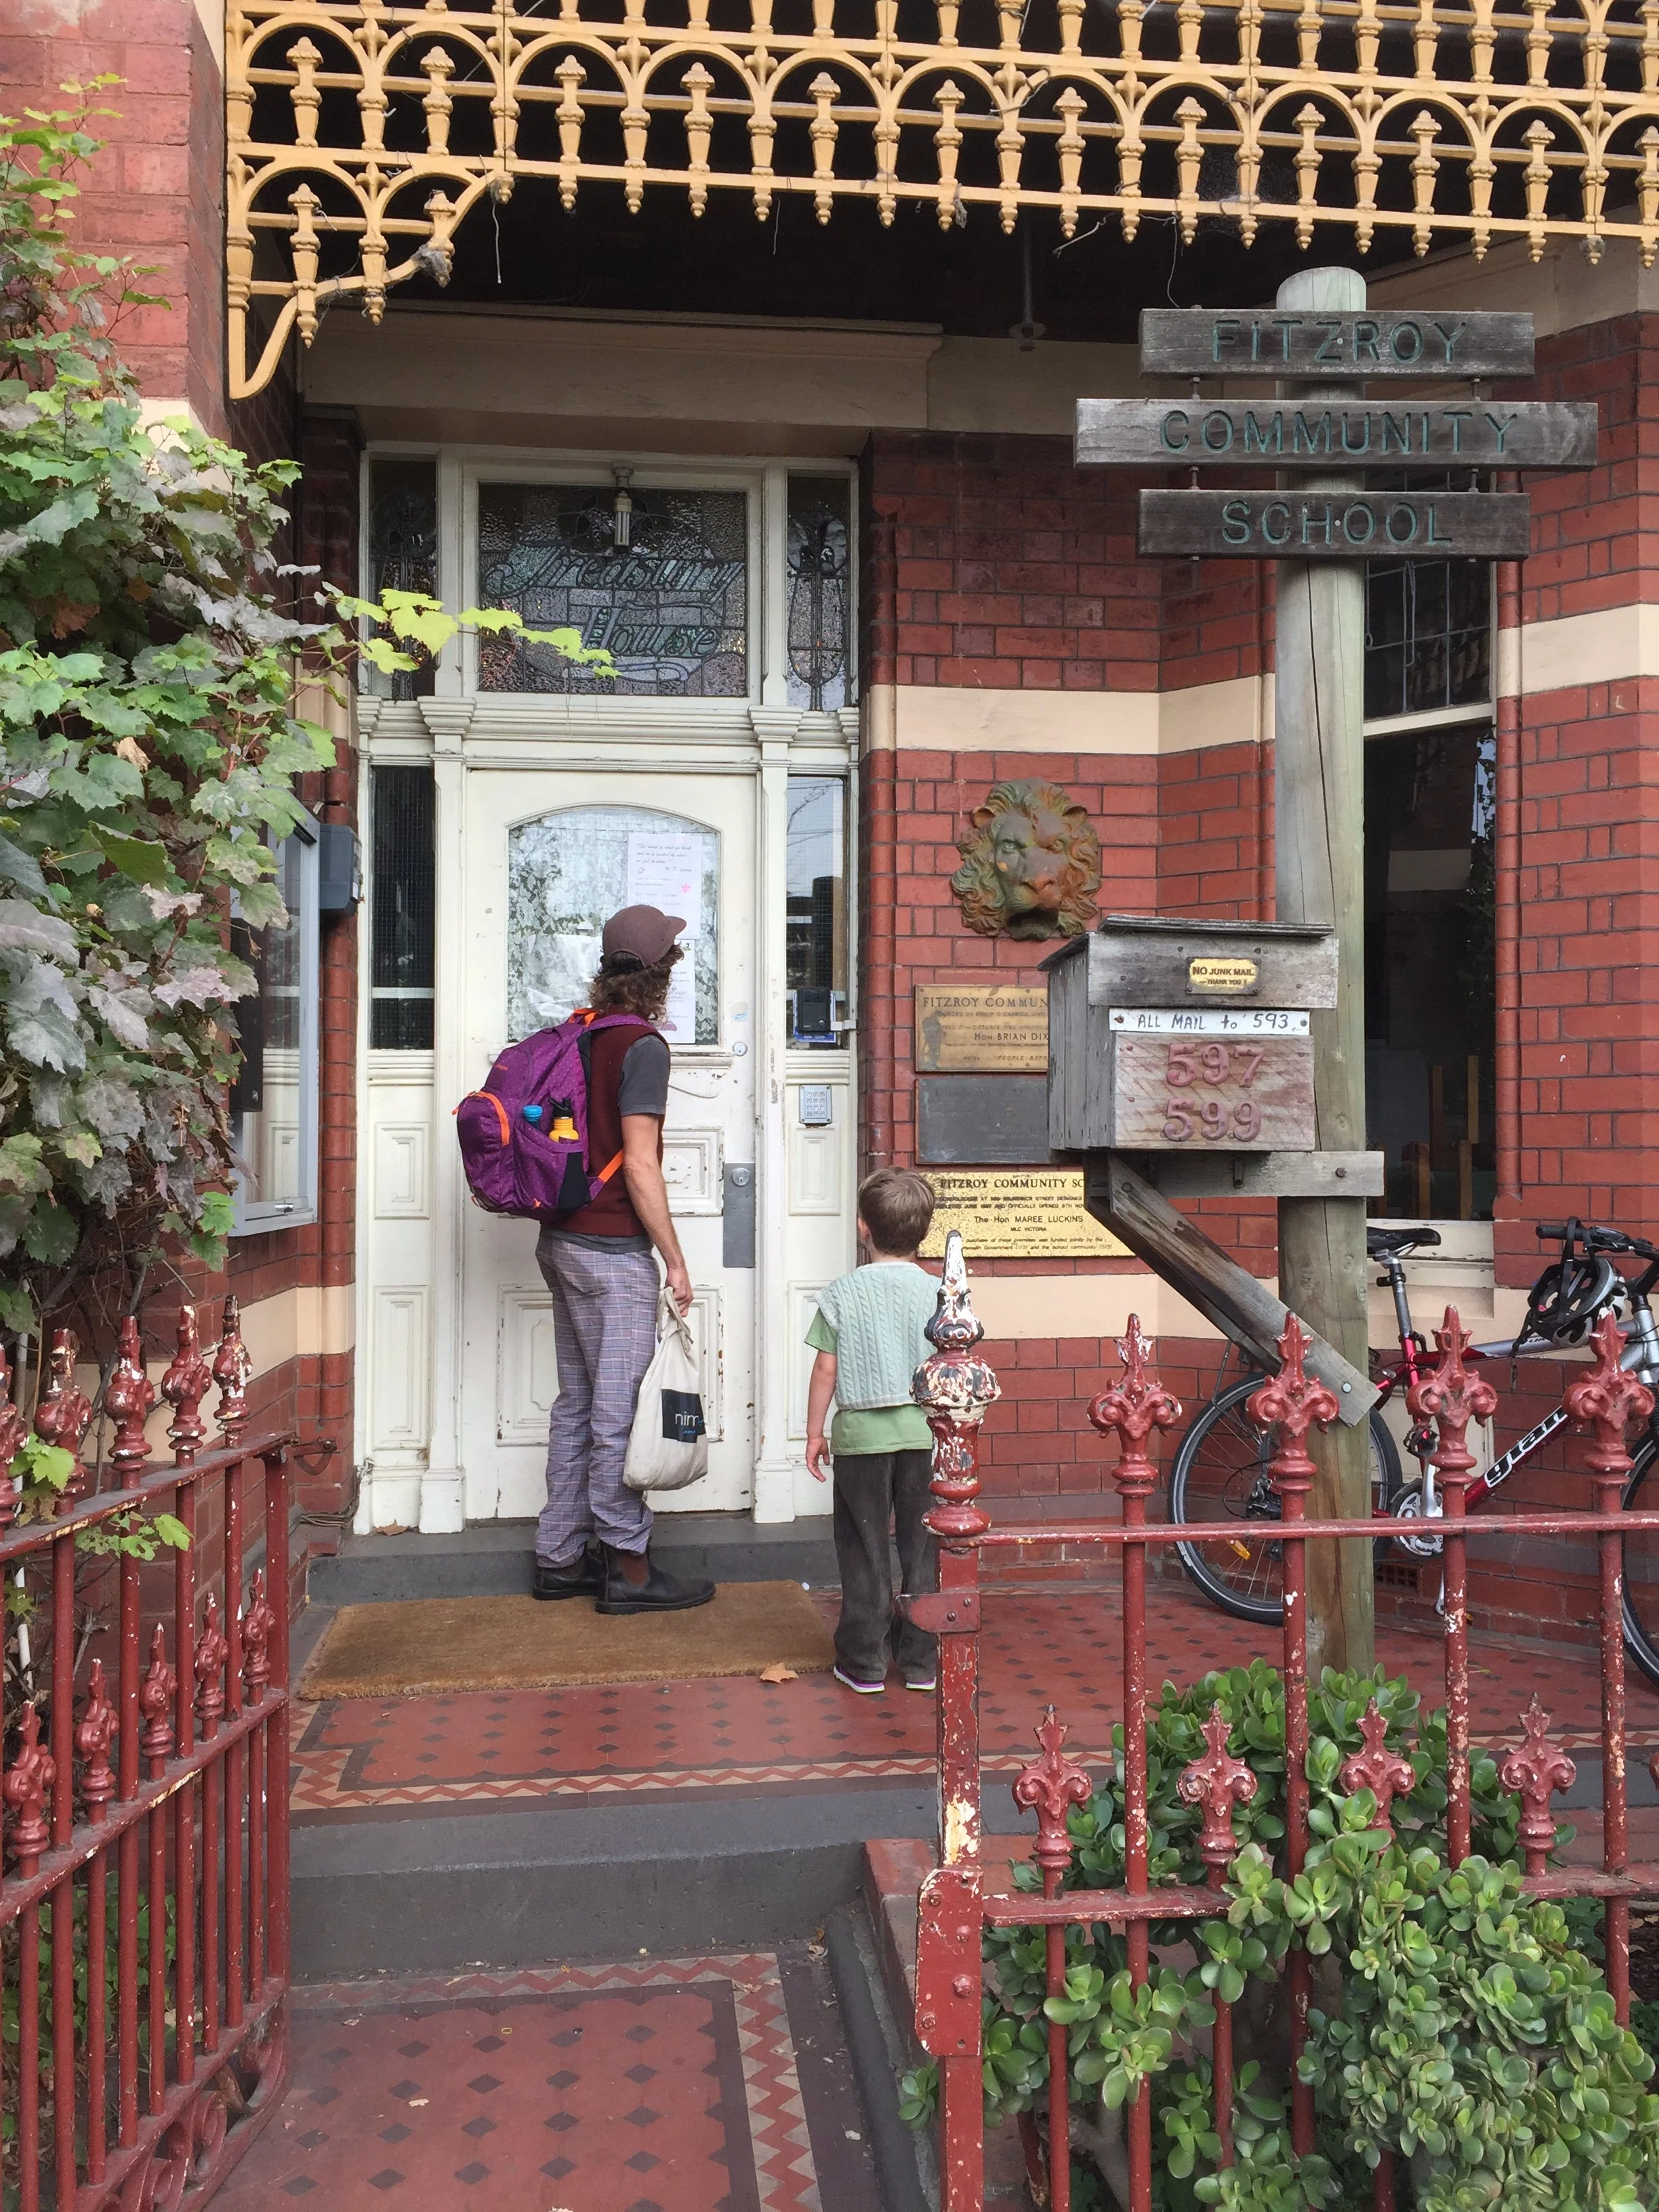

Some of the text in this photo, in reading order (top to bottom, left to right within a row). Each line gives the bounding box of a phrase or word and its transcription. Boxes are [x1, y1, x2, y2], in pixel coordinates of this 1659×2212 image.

[1211, 319, 1467, 365] FITZROY
[1160, 409, 1519, 455] COMMUNITY
[1221, 499, 1454, 545] SCHOOL
[1192, 966, 1254, 977] NO JUNK MAIL
[922, 996, 1048, 1008] FITZROY COMMUN
[997, 1032, 1027, 1041] BRIAN
[1031, 1032, 1048, 1041] DIX
[1137, 1011, 1289, 1030] ALL MAIL to 593
[1166, 1042, 1265, 1088] 597
[1162, 1098, 1263, 1143] 599
[940, 1179, 1084, 1189] FITZROY COMMUNITY SC
[1015, 1215, 1044, 1223] MAREE
[1048, 1215, 1084, 1223] LUCKINS
[1484, 1404, 1569, 1488] gian
